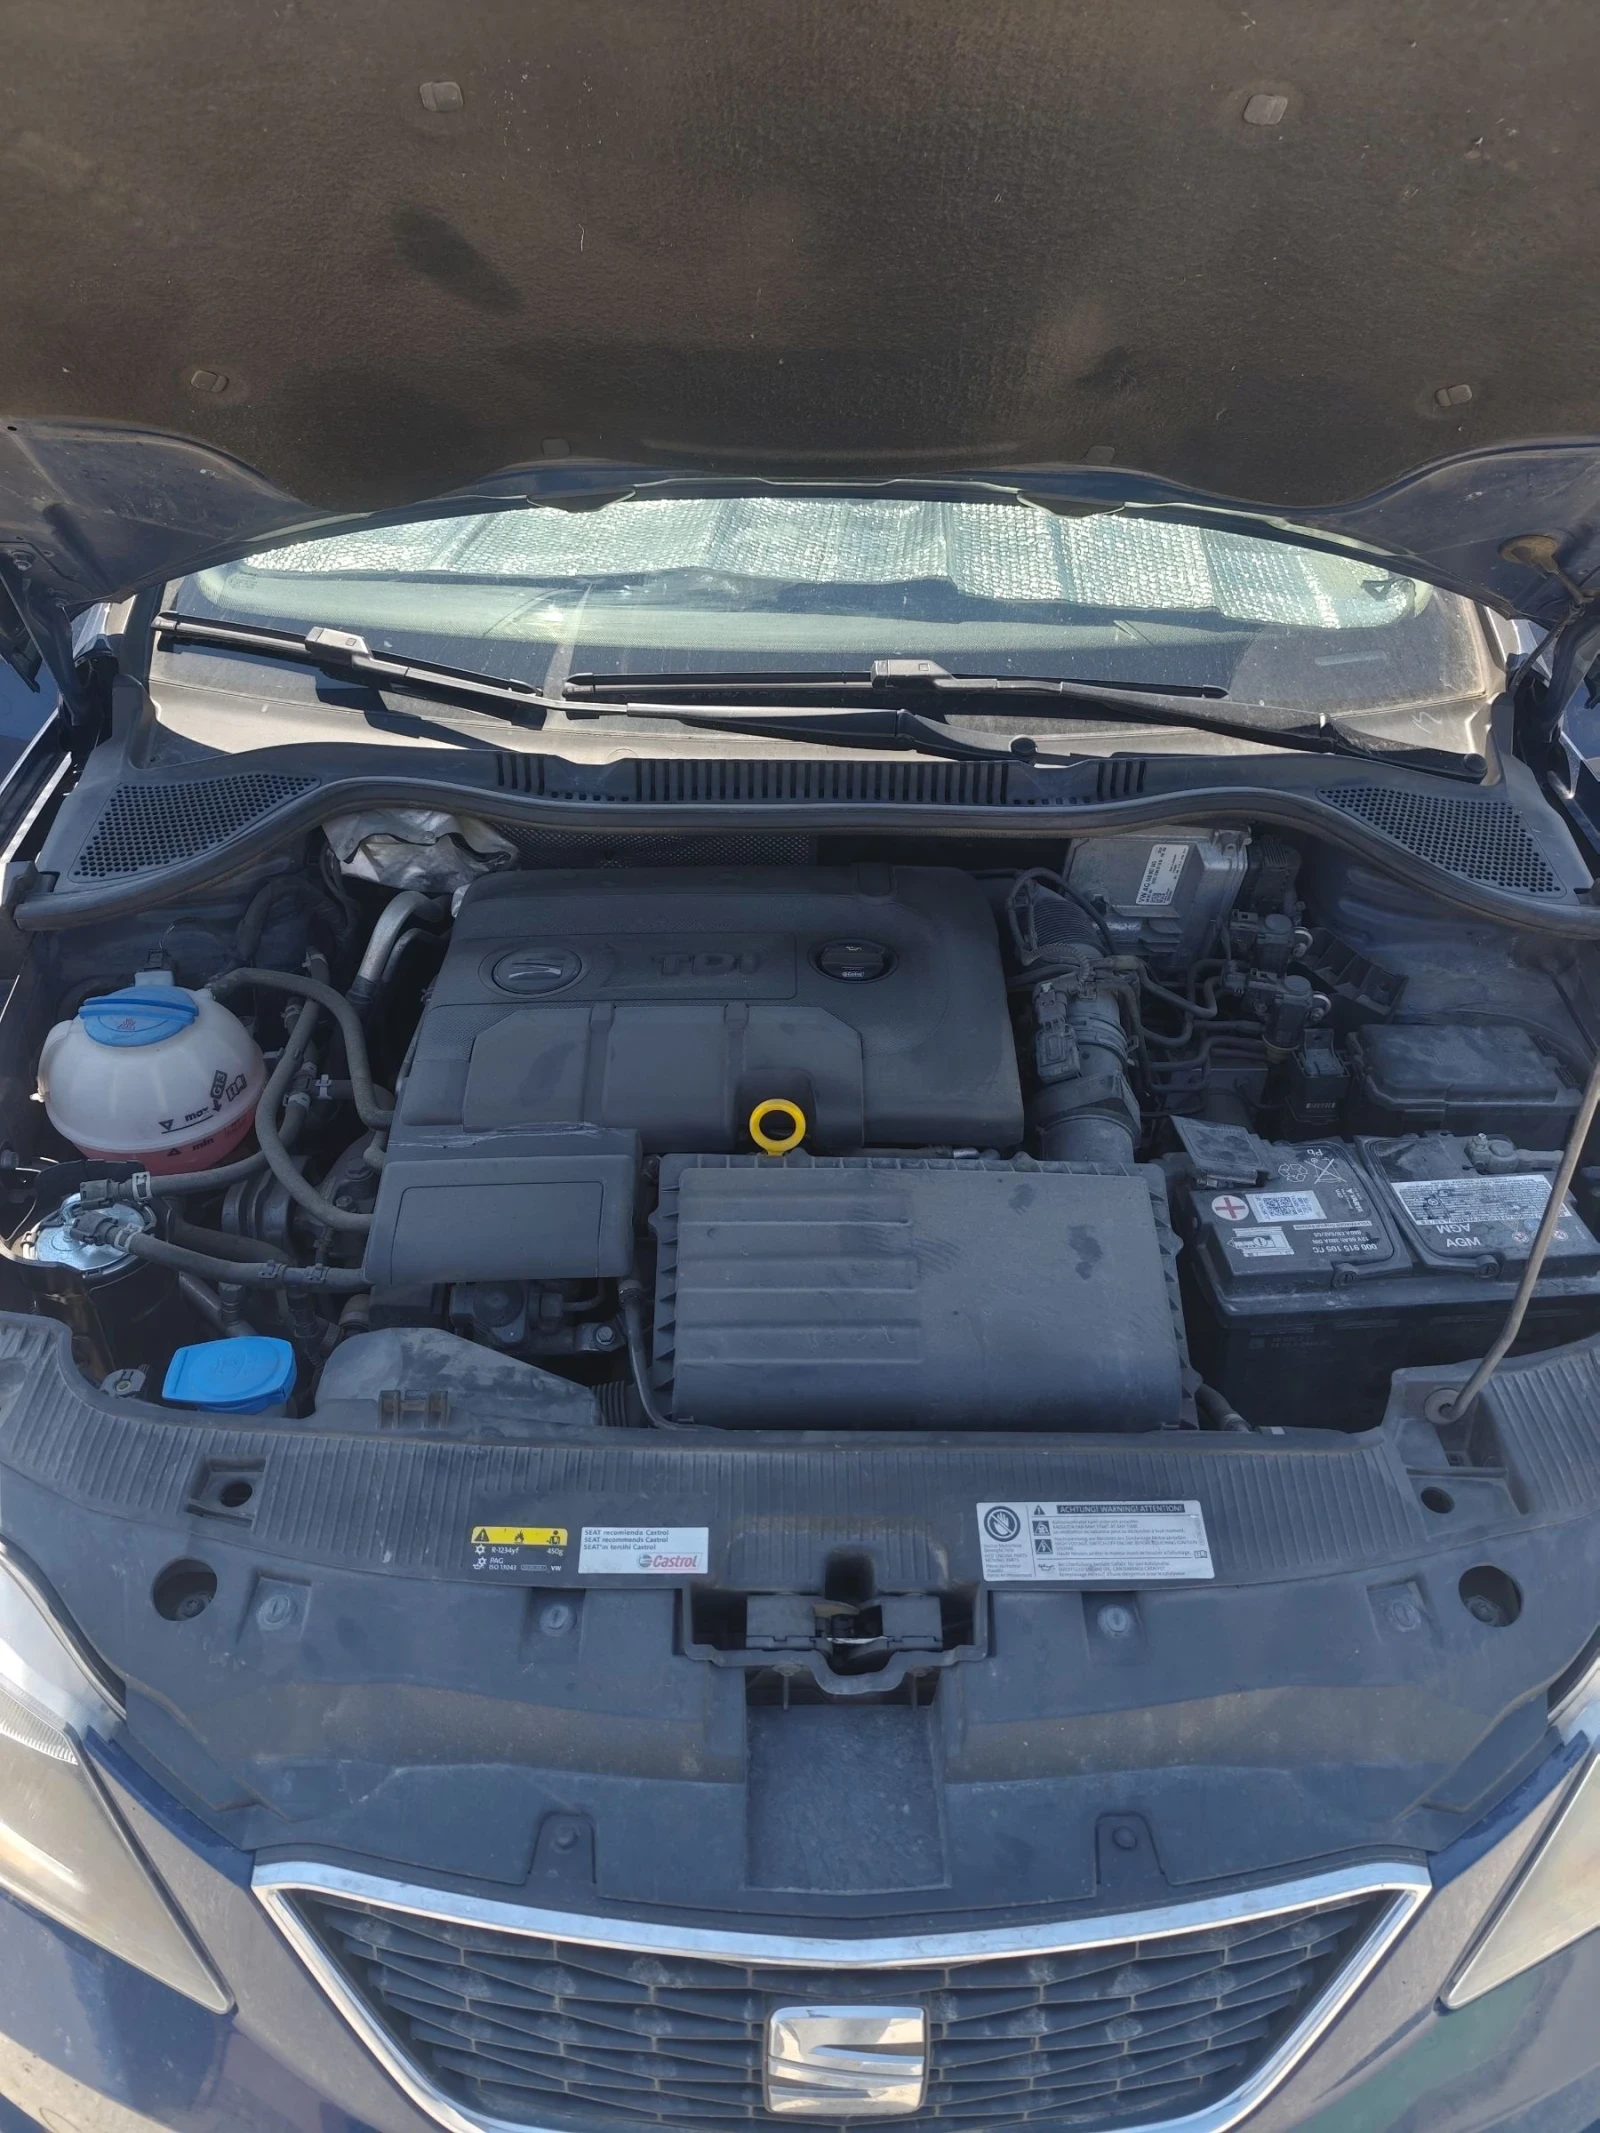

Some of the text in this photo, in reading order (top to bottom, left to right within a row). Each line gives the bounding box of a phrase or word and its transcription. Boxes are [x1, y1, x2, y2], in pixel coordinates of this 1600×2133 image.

[192, 1138, 214, 1151] min
[1436, 1223, 1470, 1233] AGM
[1446, 1236, 1482, 1247] AGM
[1344, 1244, 1360, 1252] 915
[1100, 1505, 1138, 1513] WARNING!
[1140, 1504, 1183, 1512] ATTENTION!
[546, 1548, 564, 1557] 450g
[653, 1555, 698, 1568] Castrol
